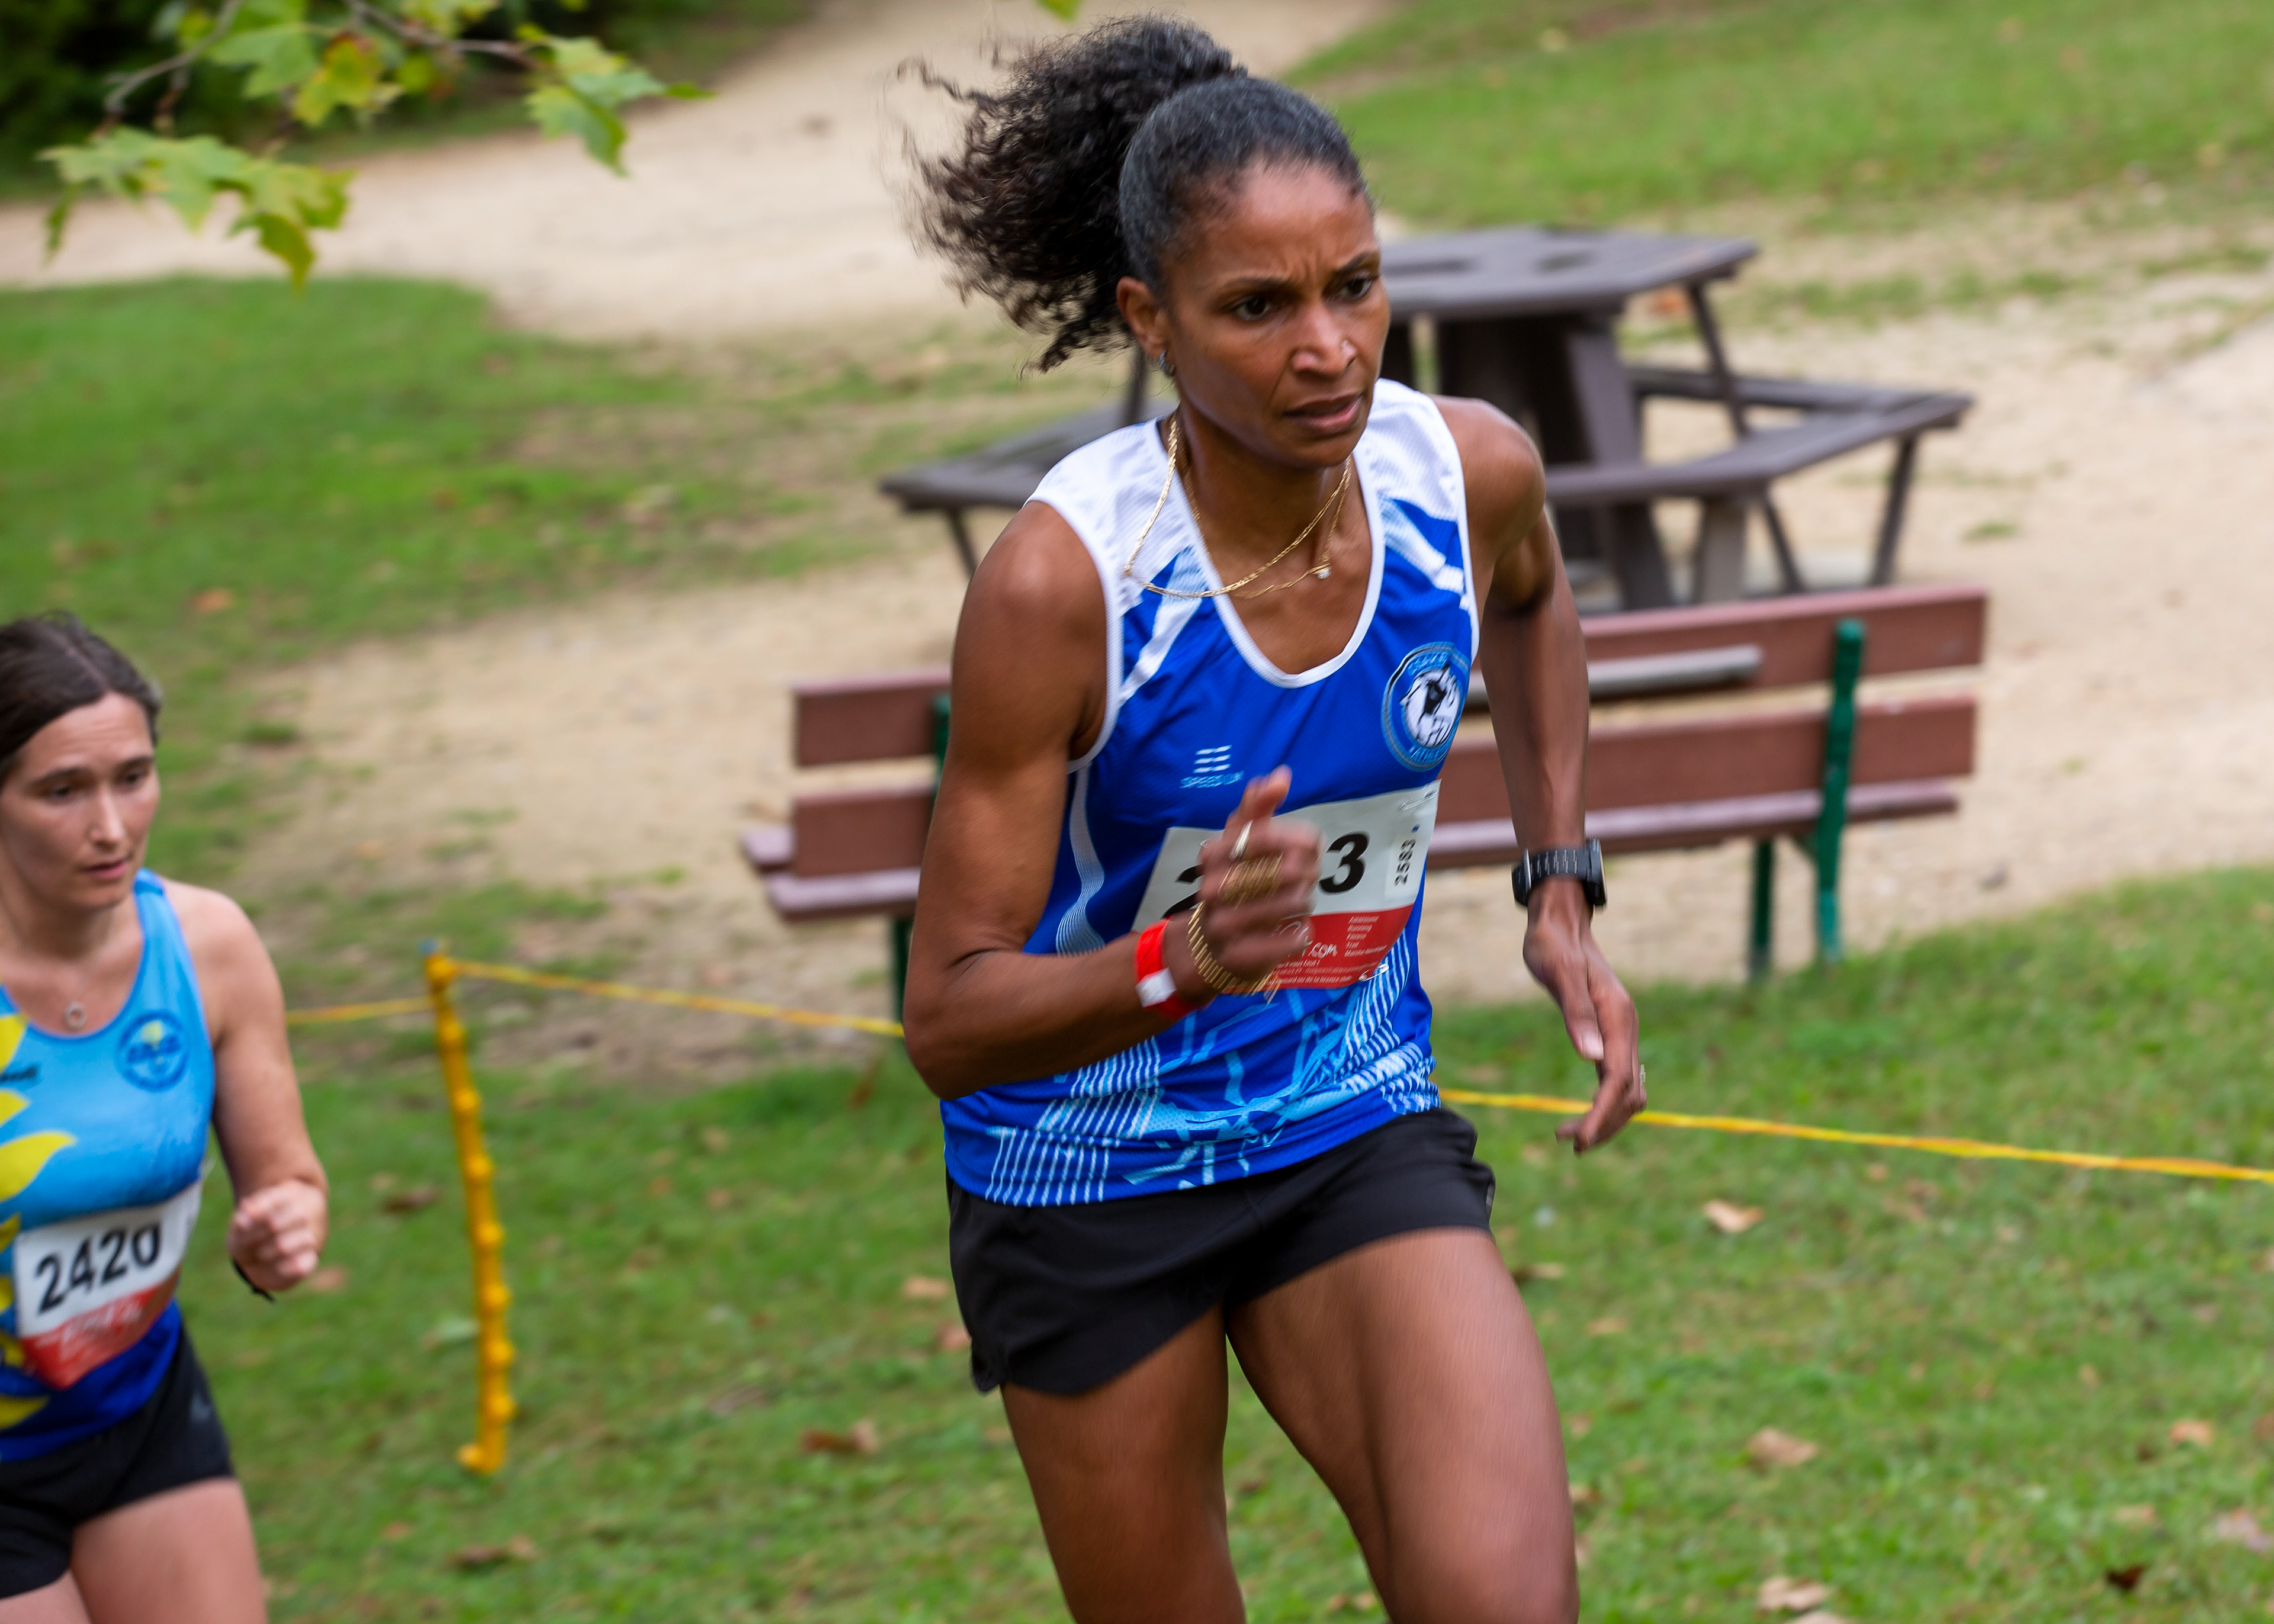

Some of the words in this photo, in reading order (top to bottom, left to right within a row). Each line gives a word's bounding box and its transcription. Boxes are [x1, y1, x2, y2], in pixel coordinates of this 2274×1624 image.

[1393, 839, 1417, 886] 2583
[1347, 924, 1373, 932] Running
[35, 1221, 164, 1316] 2420
